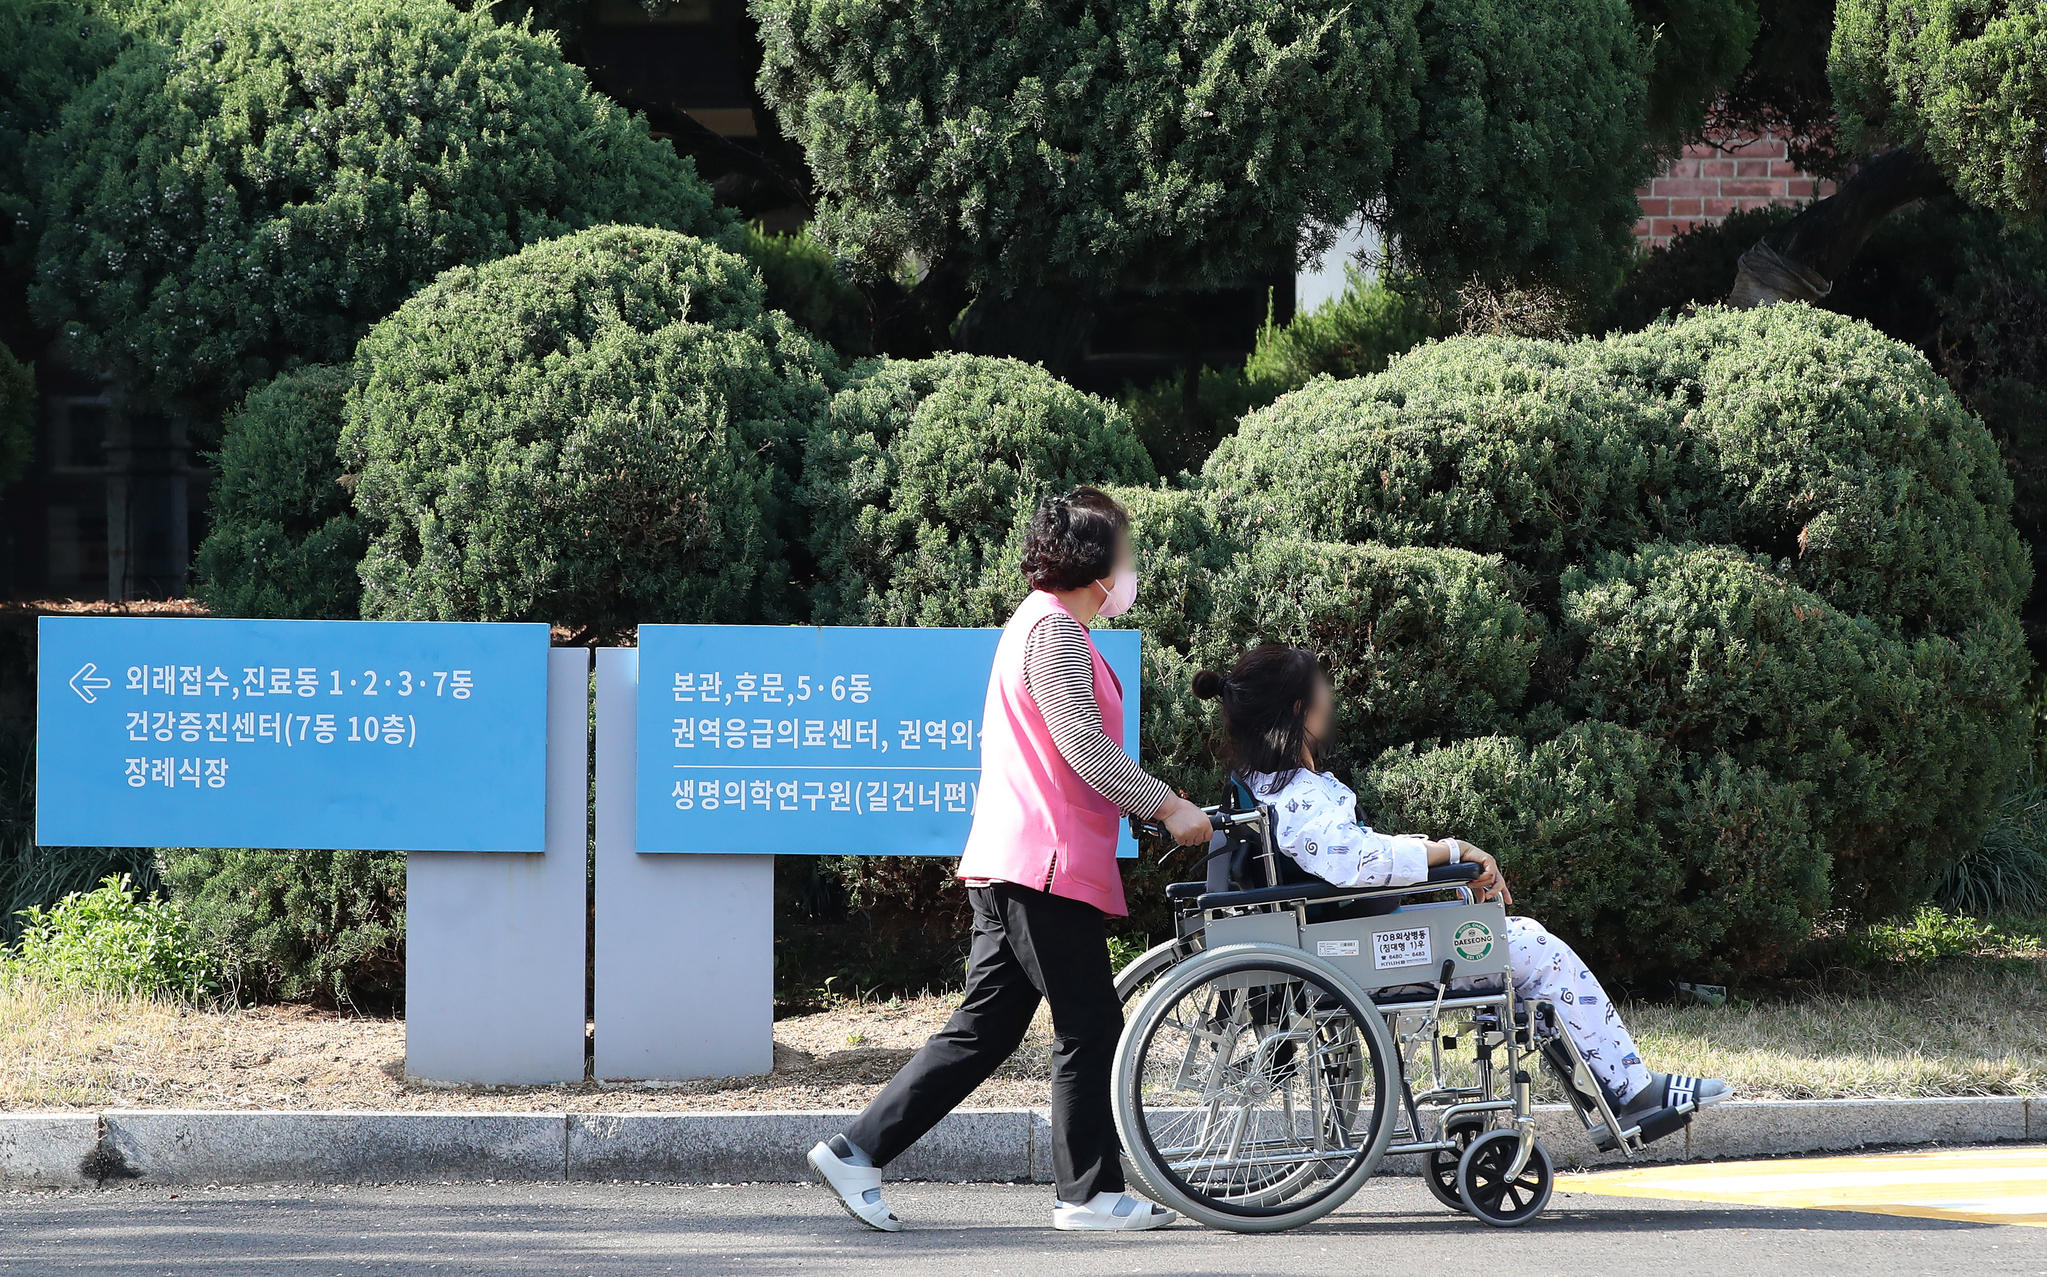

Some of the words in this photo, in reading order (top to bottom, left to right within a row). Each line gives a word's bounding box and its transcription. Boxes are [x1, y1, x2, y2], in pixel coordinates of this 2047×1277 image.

[125, 664, 319, 700] 외래접수,진료동
[329, 670, 474, 701] 1·2·3·7동
[671, 671, 873, 707] 본관,후문,5·6동
[125, 711, 338, 747] 건강증진센터(7동
[347, 713, 416, 748] 10층)
[671, 717, 889, 754] 권역응급의료센터,
[897, 719, 982, 751] 권역외
[124, 756, 229, 789] 장례식장
[671, 779, 977, 817] 생명의학연구원(길건너편)
[1376, 930, 1426, 942] 708외상병동
[1454, 935, 1492, 947] DAESEONG
